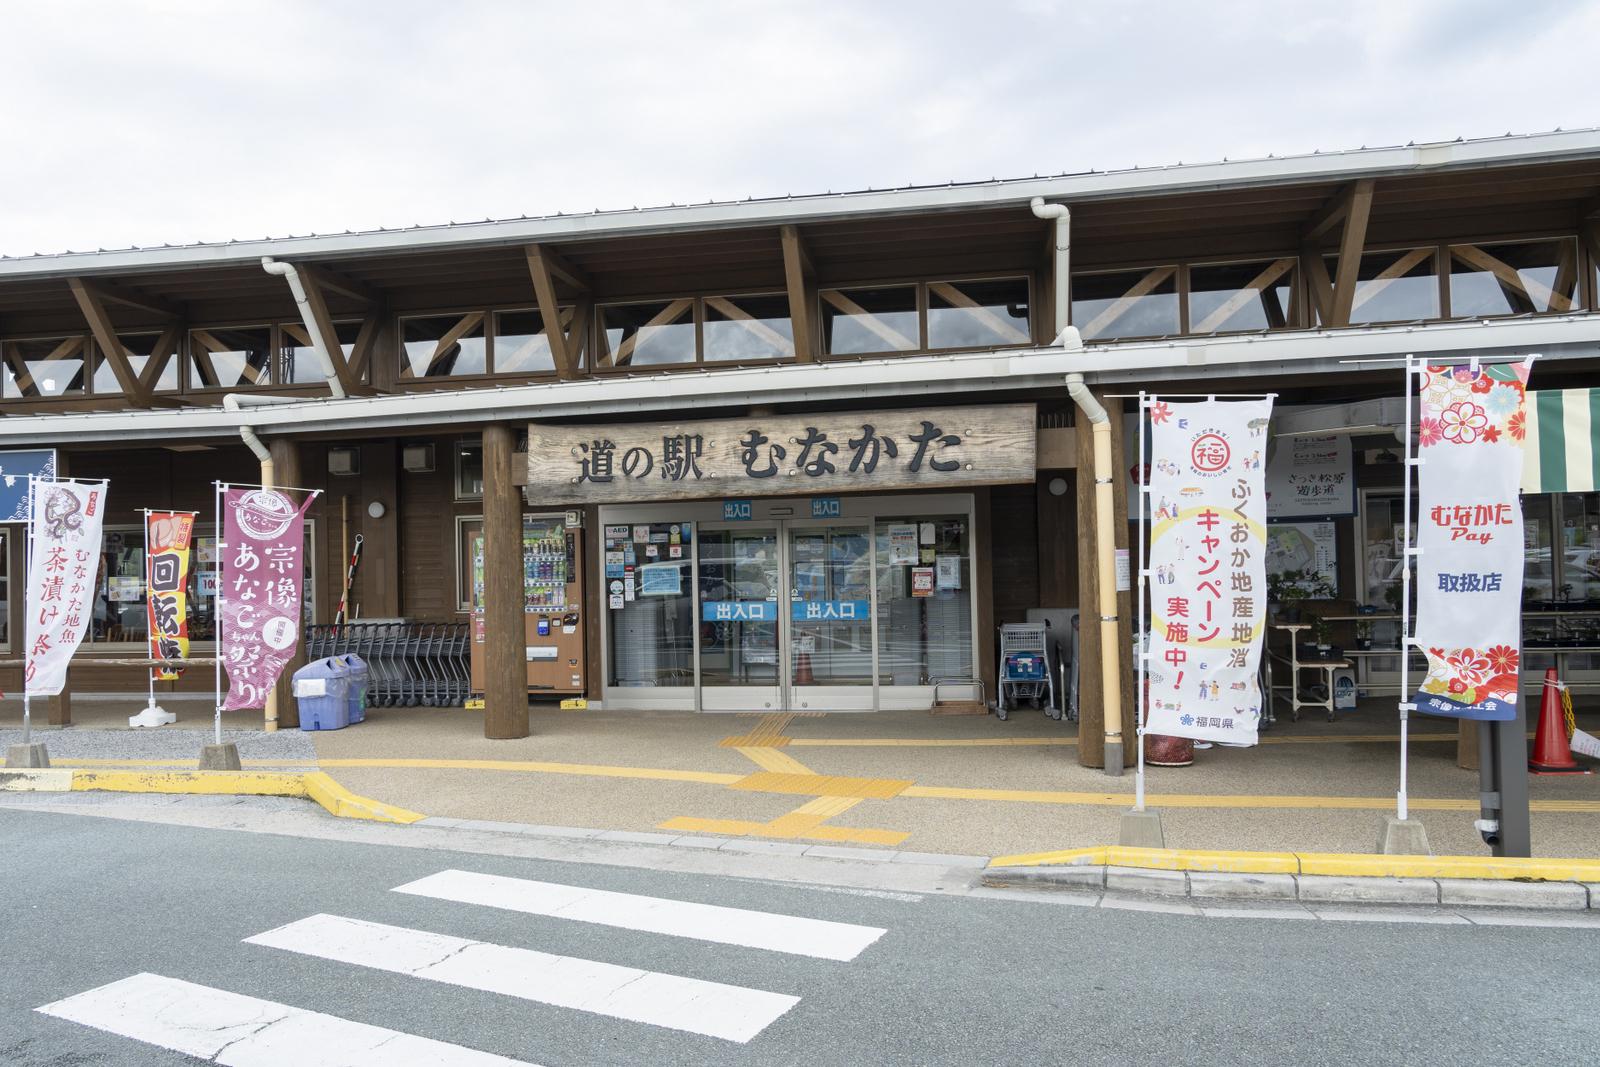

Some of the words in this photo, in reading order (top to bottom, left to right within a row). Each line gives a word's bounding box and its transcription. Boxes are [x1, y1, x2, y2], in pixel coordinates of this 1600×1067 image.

[577, 434, 703, 483] 道の駅
[740, 420, 962, 479] むなかた
[724, 503, 751, 518] 出入口
[813, 499, 840, 516] 出入口
[1430, 503, 1513, 527] むなかた
[1450, 527, 1494, 546] Pay
[265, 543, 297, 608] 宗像
[1197, 508, 1221, 643] キャンペーン
[1227, 478, 1254, 668] ふくおか地産地消
[1438, 572, 1501, 594] 取扱店
[58, 549, 90, 644] むなかた地魚
[716, 603, 764, 620] 出入口
[807, 602, 855, 619] 出入口
[1165, 596, 1189, 691] 実施中!
[1196, 716, 1234, 730] 福岡県
